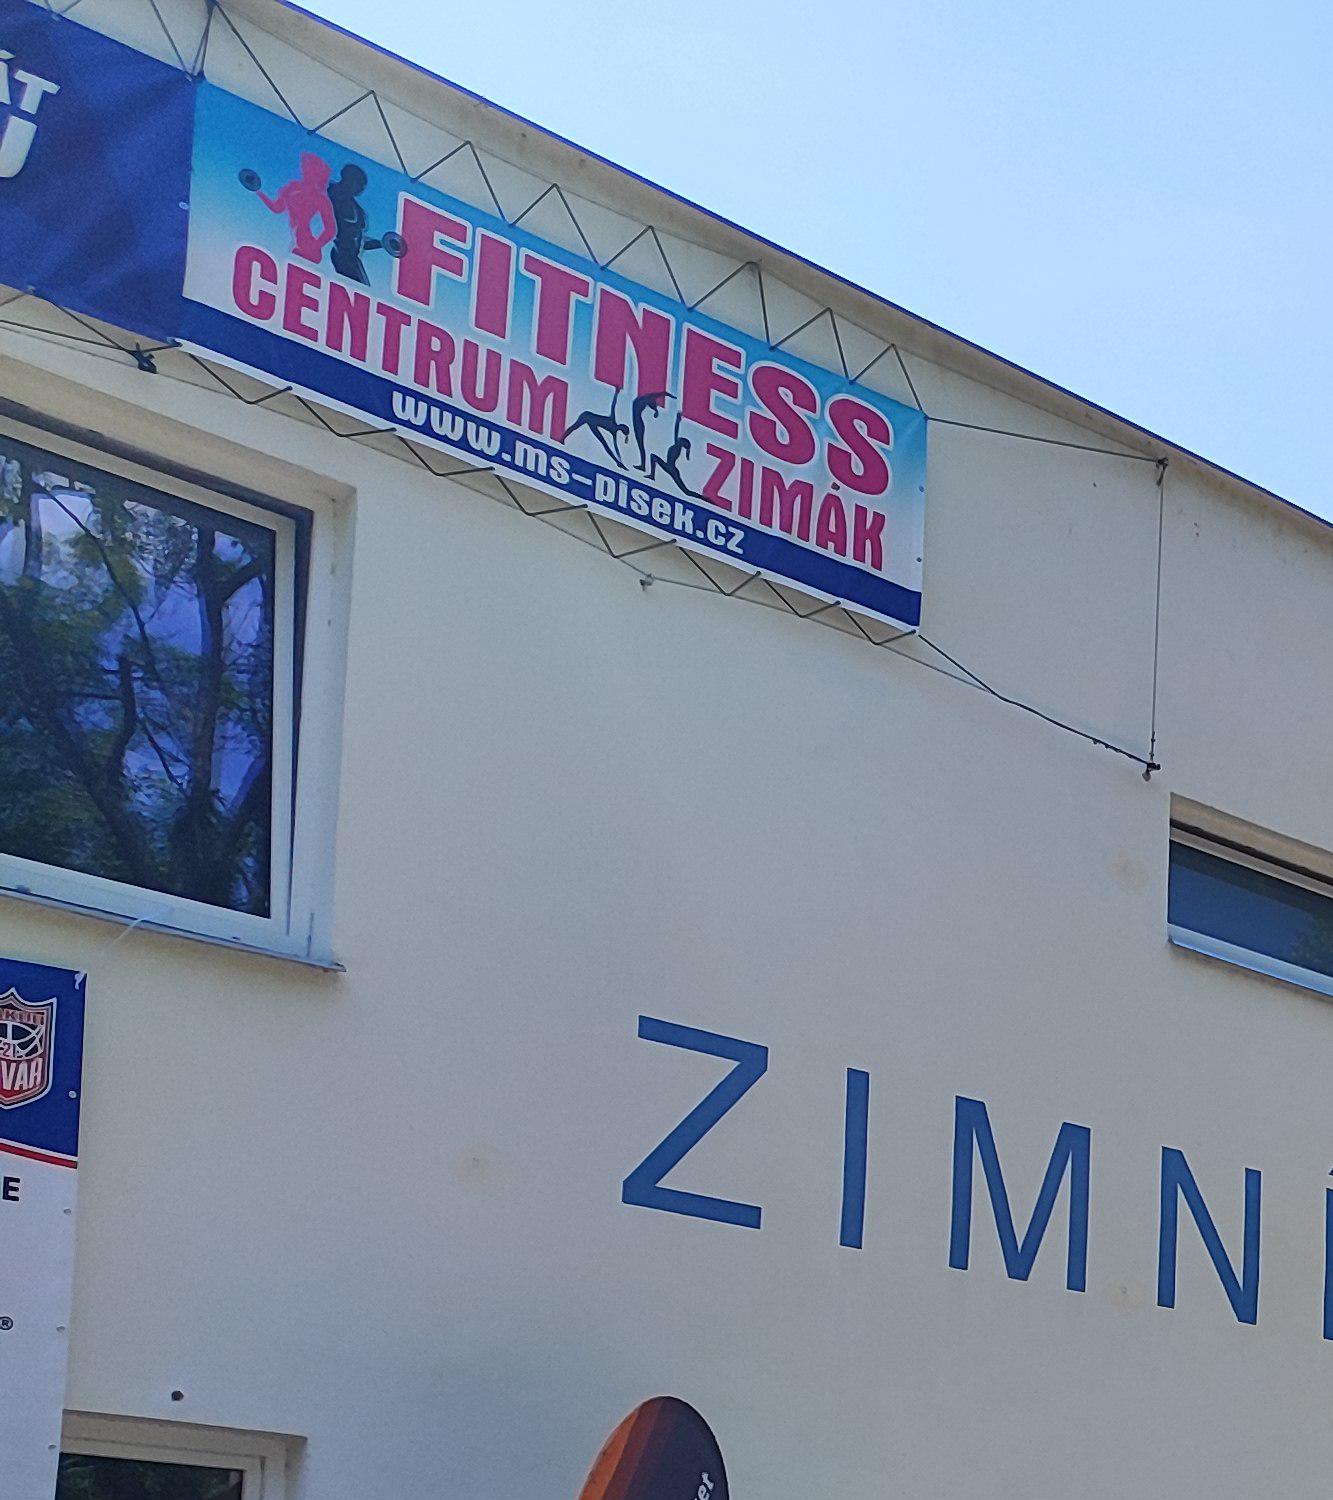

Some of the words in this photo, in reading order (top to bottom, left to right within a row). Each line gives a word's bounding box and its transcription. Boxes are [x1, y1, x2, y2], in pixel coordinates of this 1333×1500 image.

[231, 245, 570, 445] CENTRUM
[394, 193, 893, 497] FITNESS
[391, 390, 746, 555] www.ms-pisek.cz
